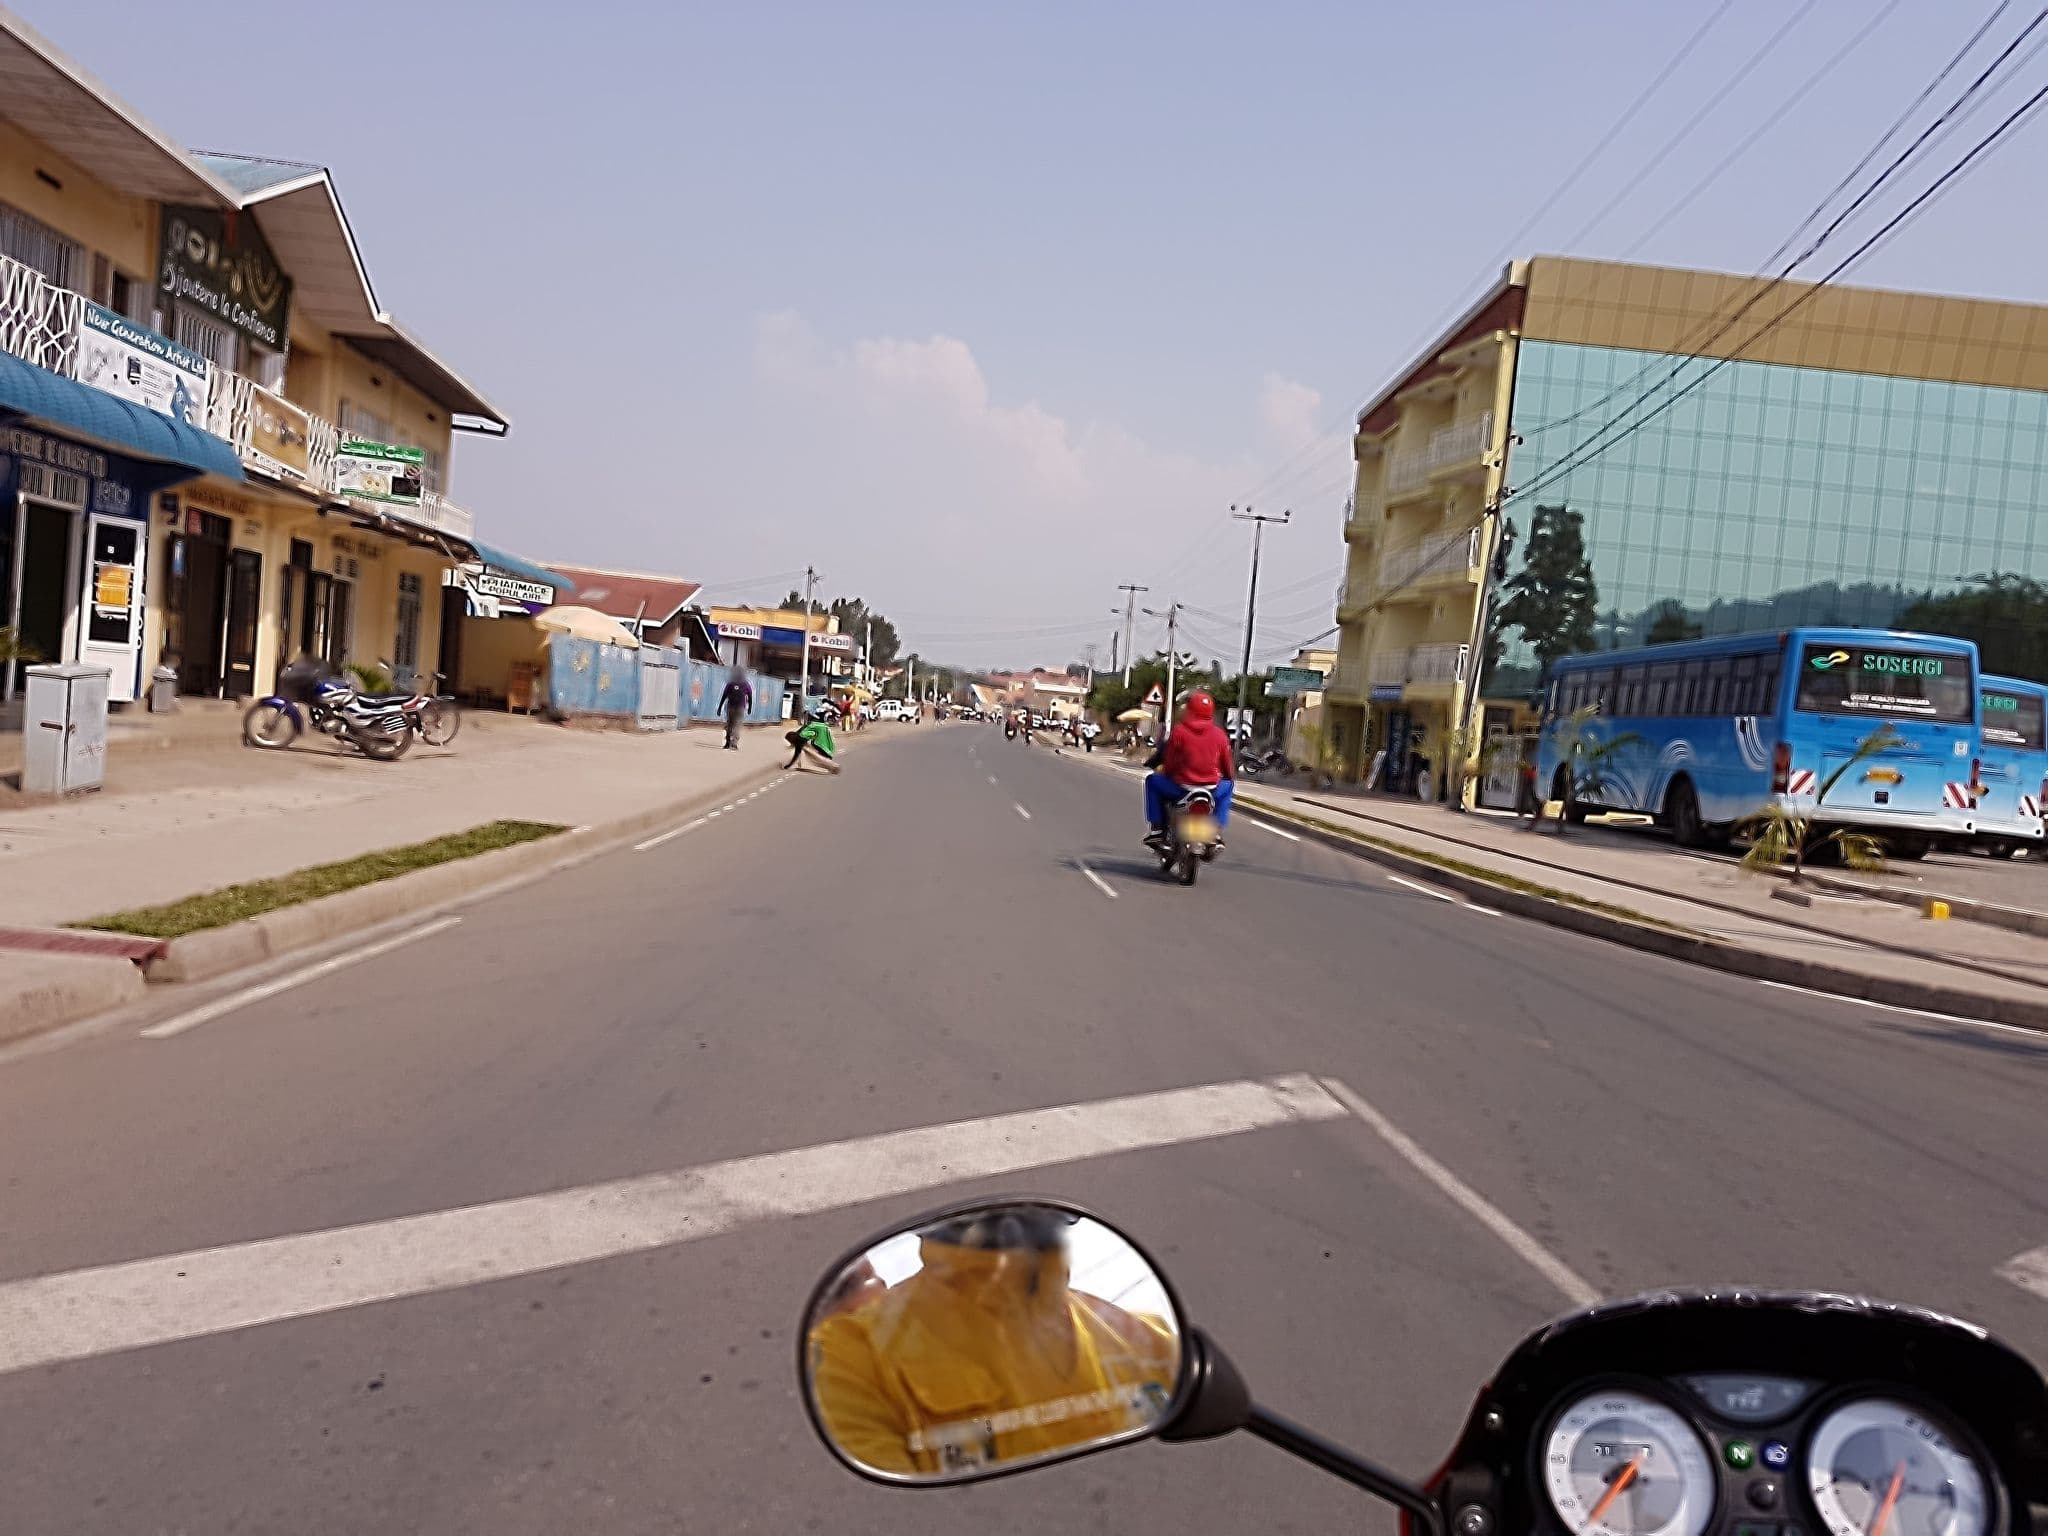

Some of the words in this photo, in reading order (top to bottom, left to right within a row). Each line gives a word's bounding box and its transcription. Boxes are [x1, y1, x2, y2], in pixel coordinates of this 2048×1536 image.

[488, 585, 545, 602] POPULAIRE
[730, 623, 760, 638] Kobil
[821, 636, 850, 647] Kobil
[1863, 654, 1943, 676] SOSERGI
[1733, 1447, 1747, 1461] N
